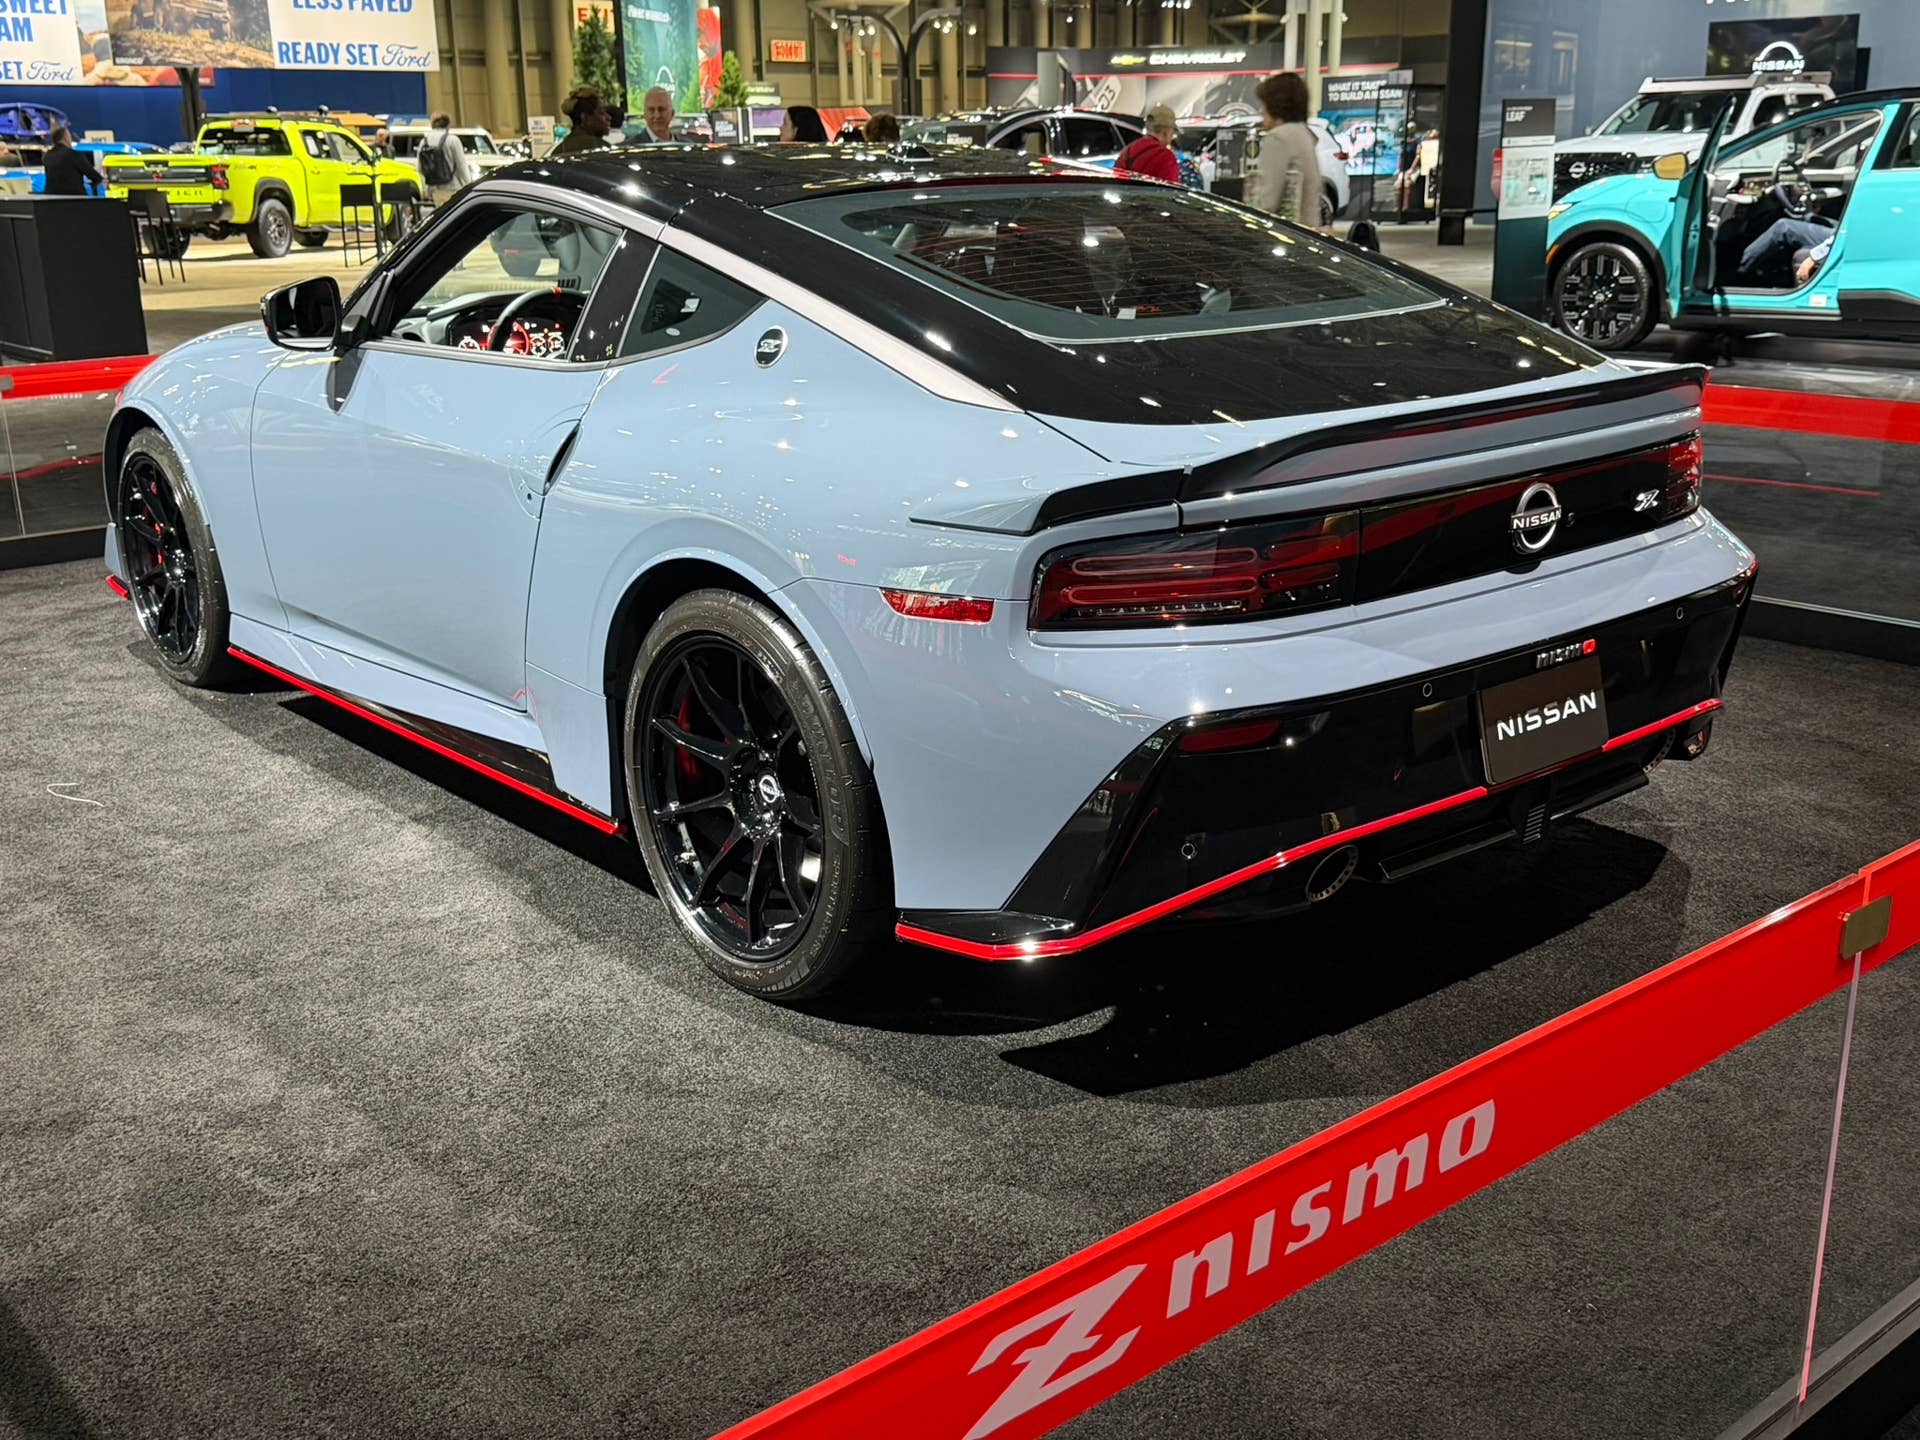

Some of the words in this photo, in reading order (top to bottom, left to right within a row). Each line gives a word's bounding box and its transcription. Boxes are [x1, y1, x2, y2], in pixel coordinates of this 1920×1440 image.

[277, 41, 340, 65] READY
[345, 43, 379, 66] SET
[381, 43, 431, 68] Ford
[774, 42, 804, 59] EXIT
[1149, 51, 1246, 65] CHEVROLET
[0, 61, 23, 80] ET
[26, 60, 74, 81] Ford
[1752, 59, 1805, 71] NISSAN
[1328, 81, 1351, 92] WHAT
[1352, 81, 1360, 91] IT
[1328, 92, 1339, 102] TO
[1340, 91, 1363, 101] BUILD
[1371, 88, 1403, 99] NSSAN
[1505, 111, 1526, 122] LEAF
[1512, 508, 1562, 530] NISSAN
[1536, 638, 1596, 669] nismo
[1496, 690, 1598, 741] NISSAN
[1165, 1098, 1497, 1320] nismo
